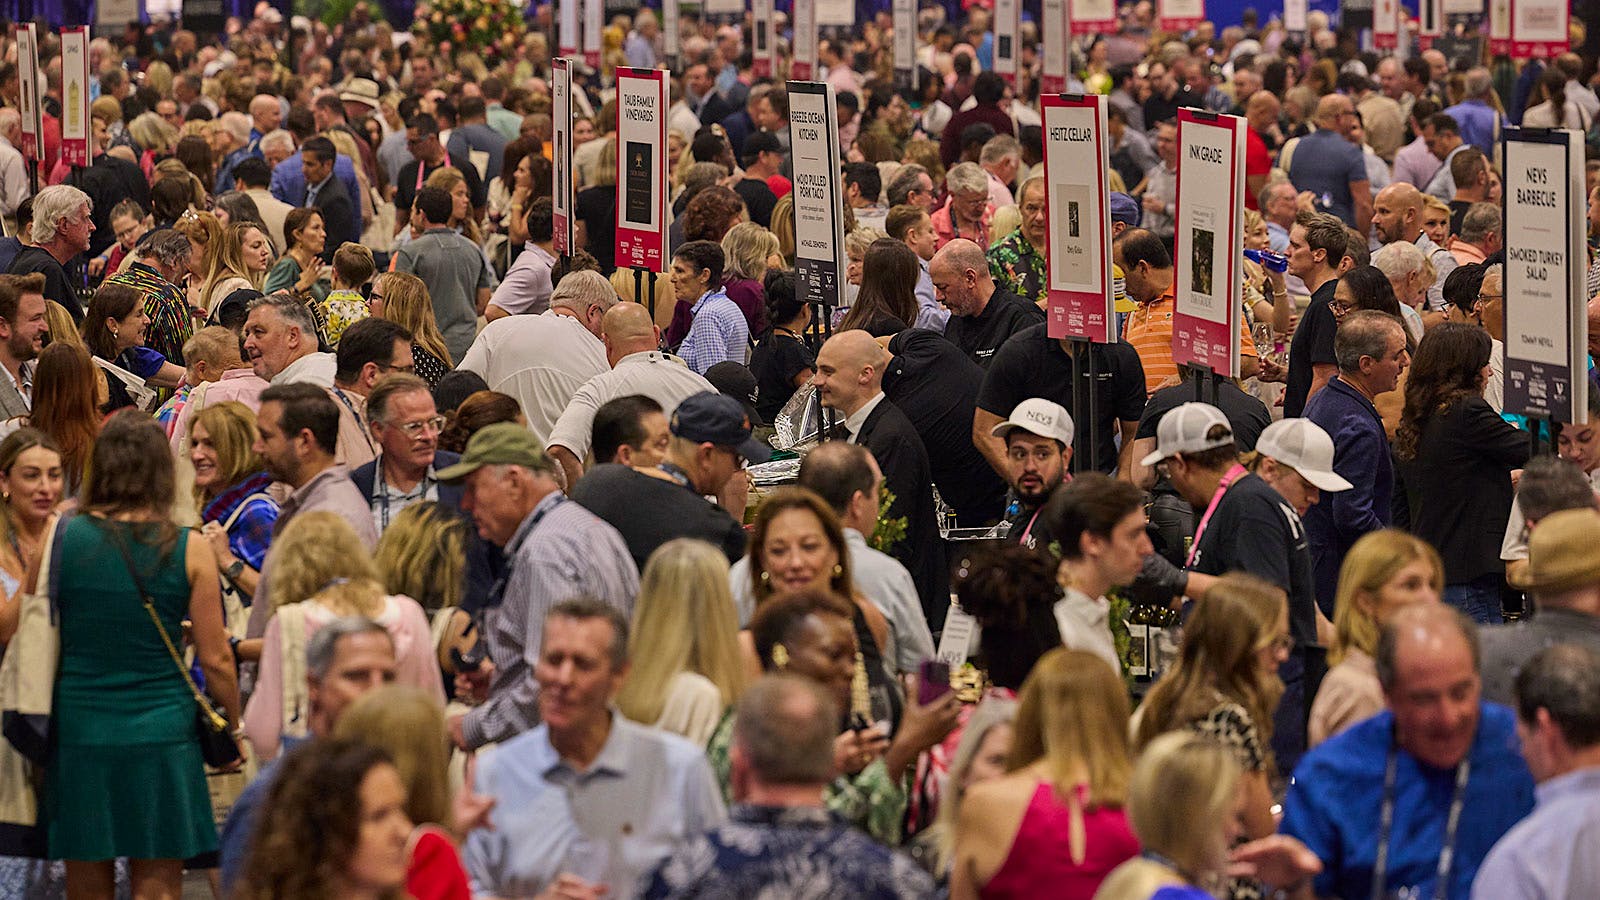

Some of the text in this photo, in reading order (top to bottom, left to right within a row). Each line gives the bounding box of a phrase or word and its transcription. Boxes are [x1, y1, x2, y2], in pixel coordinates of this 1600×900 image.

[624, 94, 655, 107] TAUB FAMILY
[625, 108, 654, 122] VINEYARDS
[791, 111, 825, 124] BREEZE OCEAN
[799, 129, 819, 141] KITCHEN
[1050, 127, 1092, 142] HEITZ CELLAR
[1189, 145, 1222, 164] INK GRADE
[796, 174, 827, 187] MOJO PULLED
[1526, 167, 1548, 184] NEVS
[800, 186, 824, 199] PORK TACO
[1517, 188, 1557, 208] BARBECUE
[1509, 247, 1563, 266] SMOKED TURKEY
[1526, 266, 1548, 281] SALAD
[1521, 334, 1538, 345] TOMMY
[1026, 410, 1053, 425] NEVS
